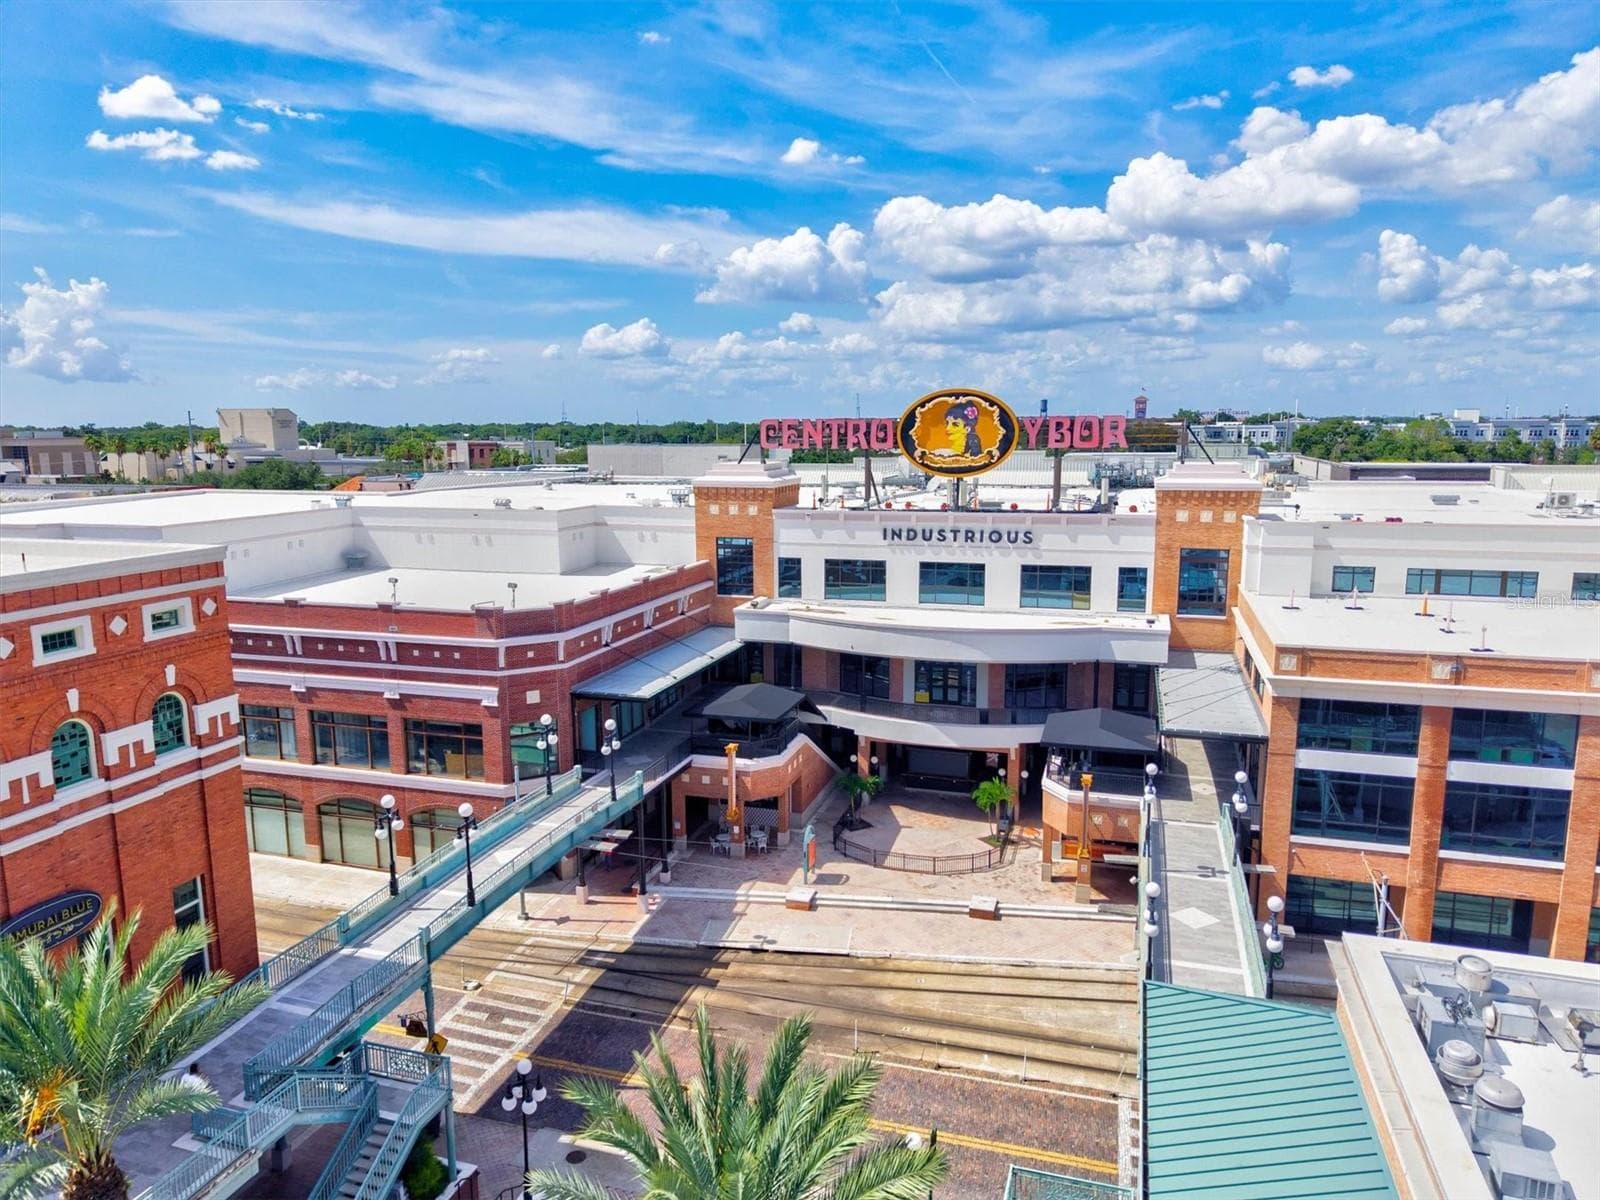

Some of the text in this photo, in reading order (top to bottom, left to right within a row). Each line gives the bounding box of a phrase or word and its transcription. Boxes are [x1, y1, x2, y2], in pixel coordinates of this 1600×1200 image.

[760, 416, 1129, 449] CENTRO YBOR
[882, 527, 1033, 544] INDUSTRIOUS
[5, 899, 93, 944] AMURAI BLUE
